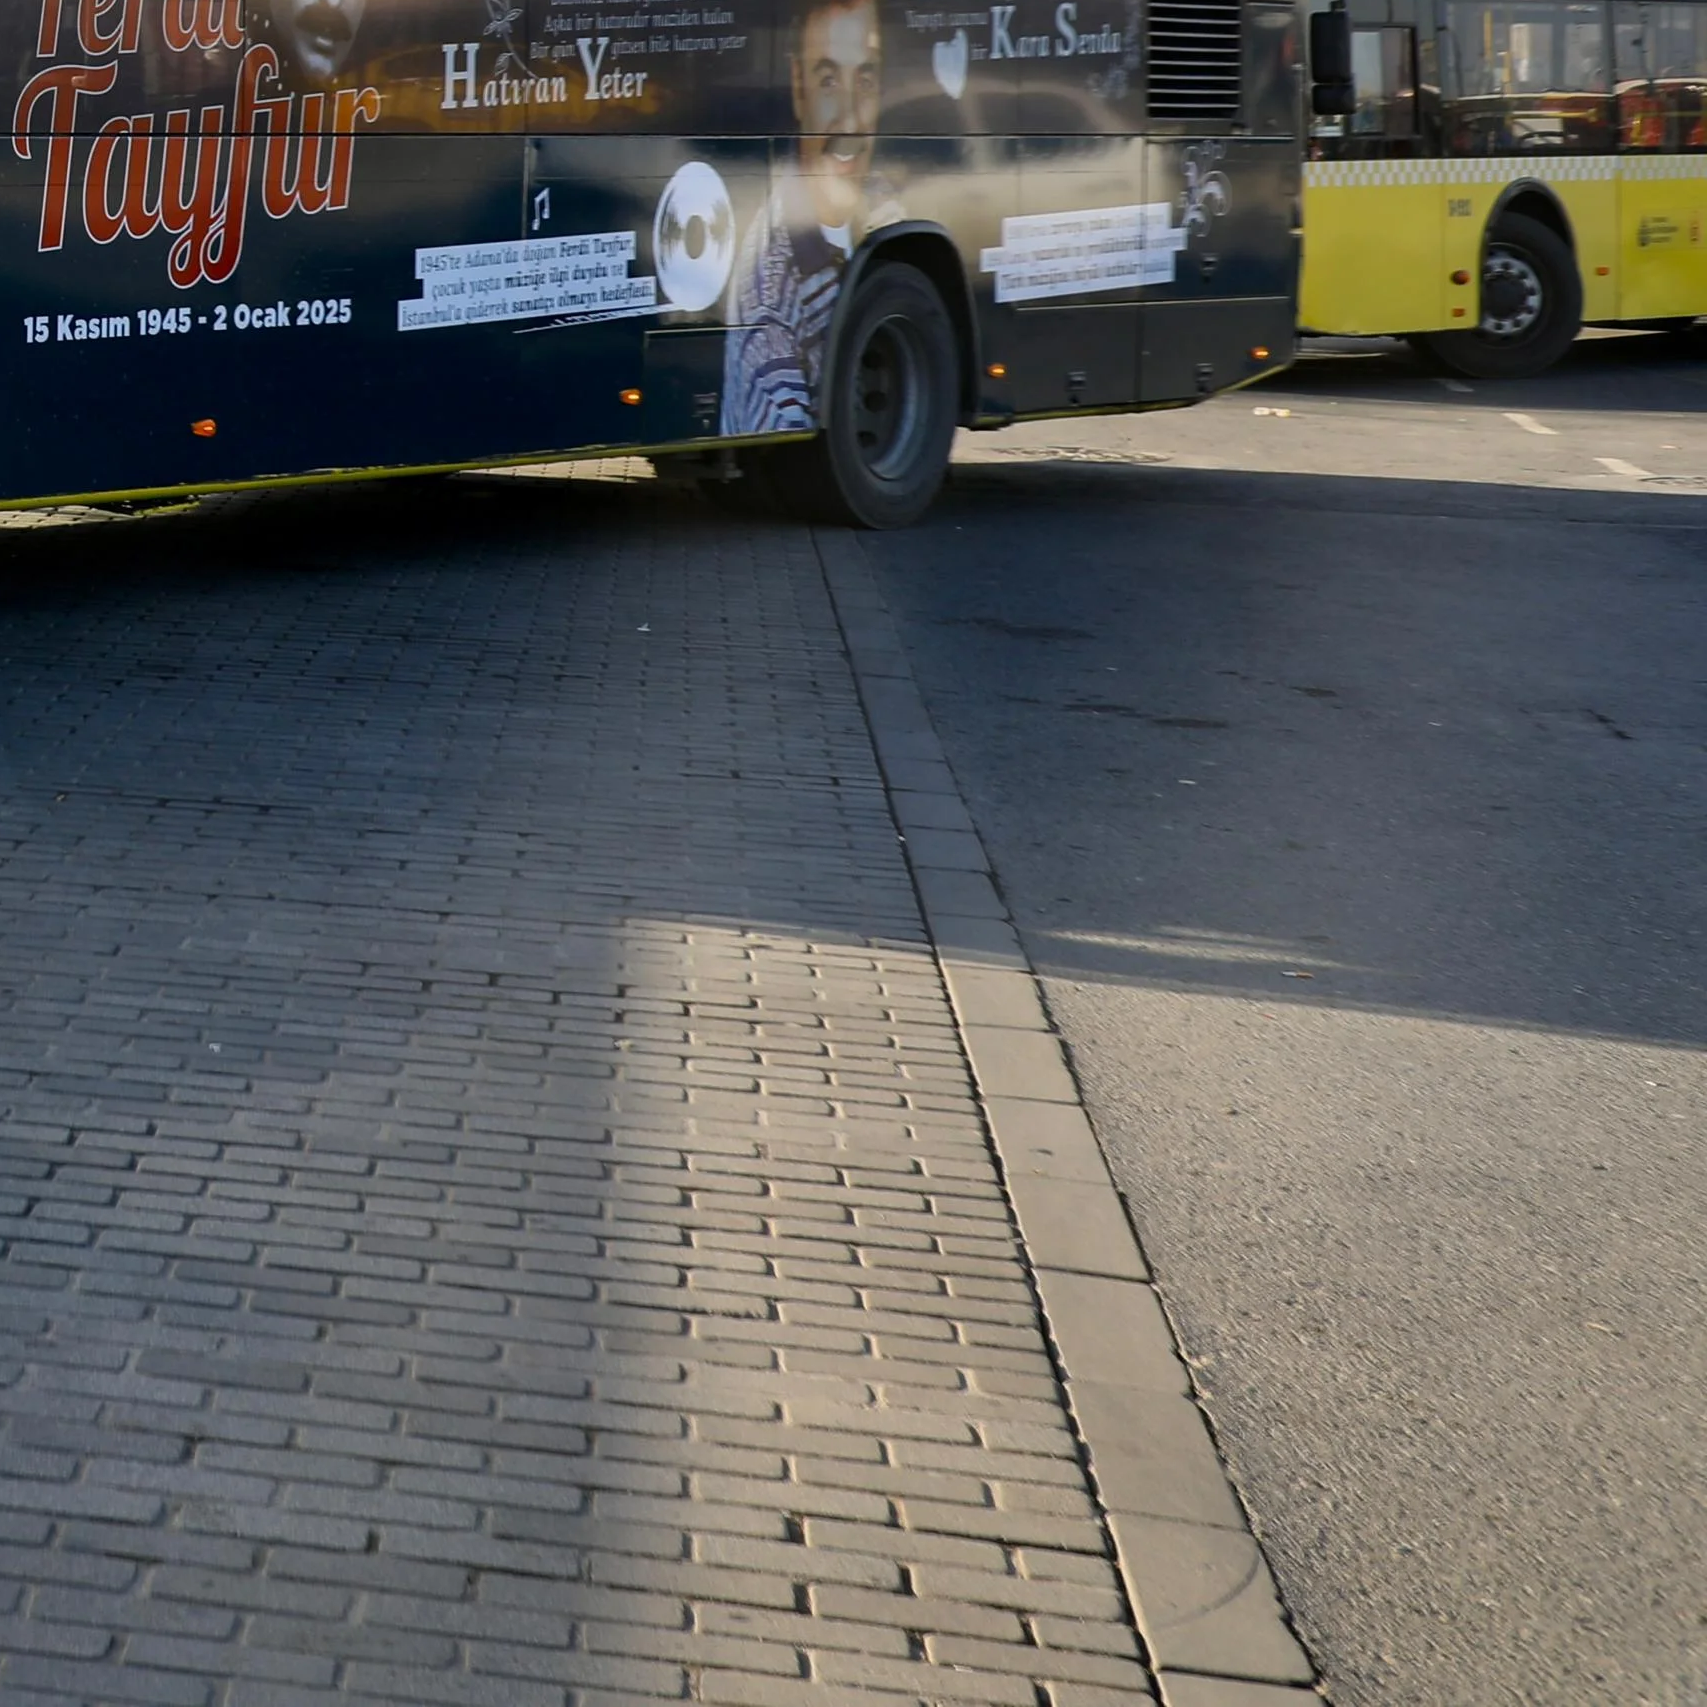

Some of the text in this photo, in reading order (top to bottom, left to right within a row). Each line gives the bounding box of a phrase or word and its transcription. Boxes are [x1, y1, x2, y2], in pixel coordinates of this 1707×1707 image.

[439, 37, 649, 110] Hatıran Yeter
[11, 44, 381, 289] Tayfur
[23, 316, 50, 343] 15
[57, 314, 131, 341] Kasım
[137, 307, 192, 336] 1945
[213, 305, 228, 331] 2
[233, 301, 291, 329] Ocak
[296, 299, 352, 326] 2025
